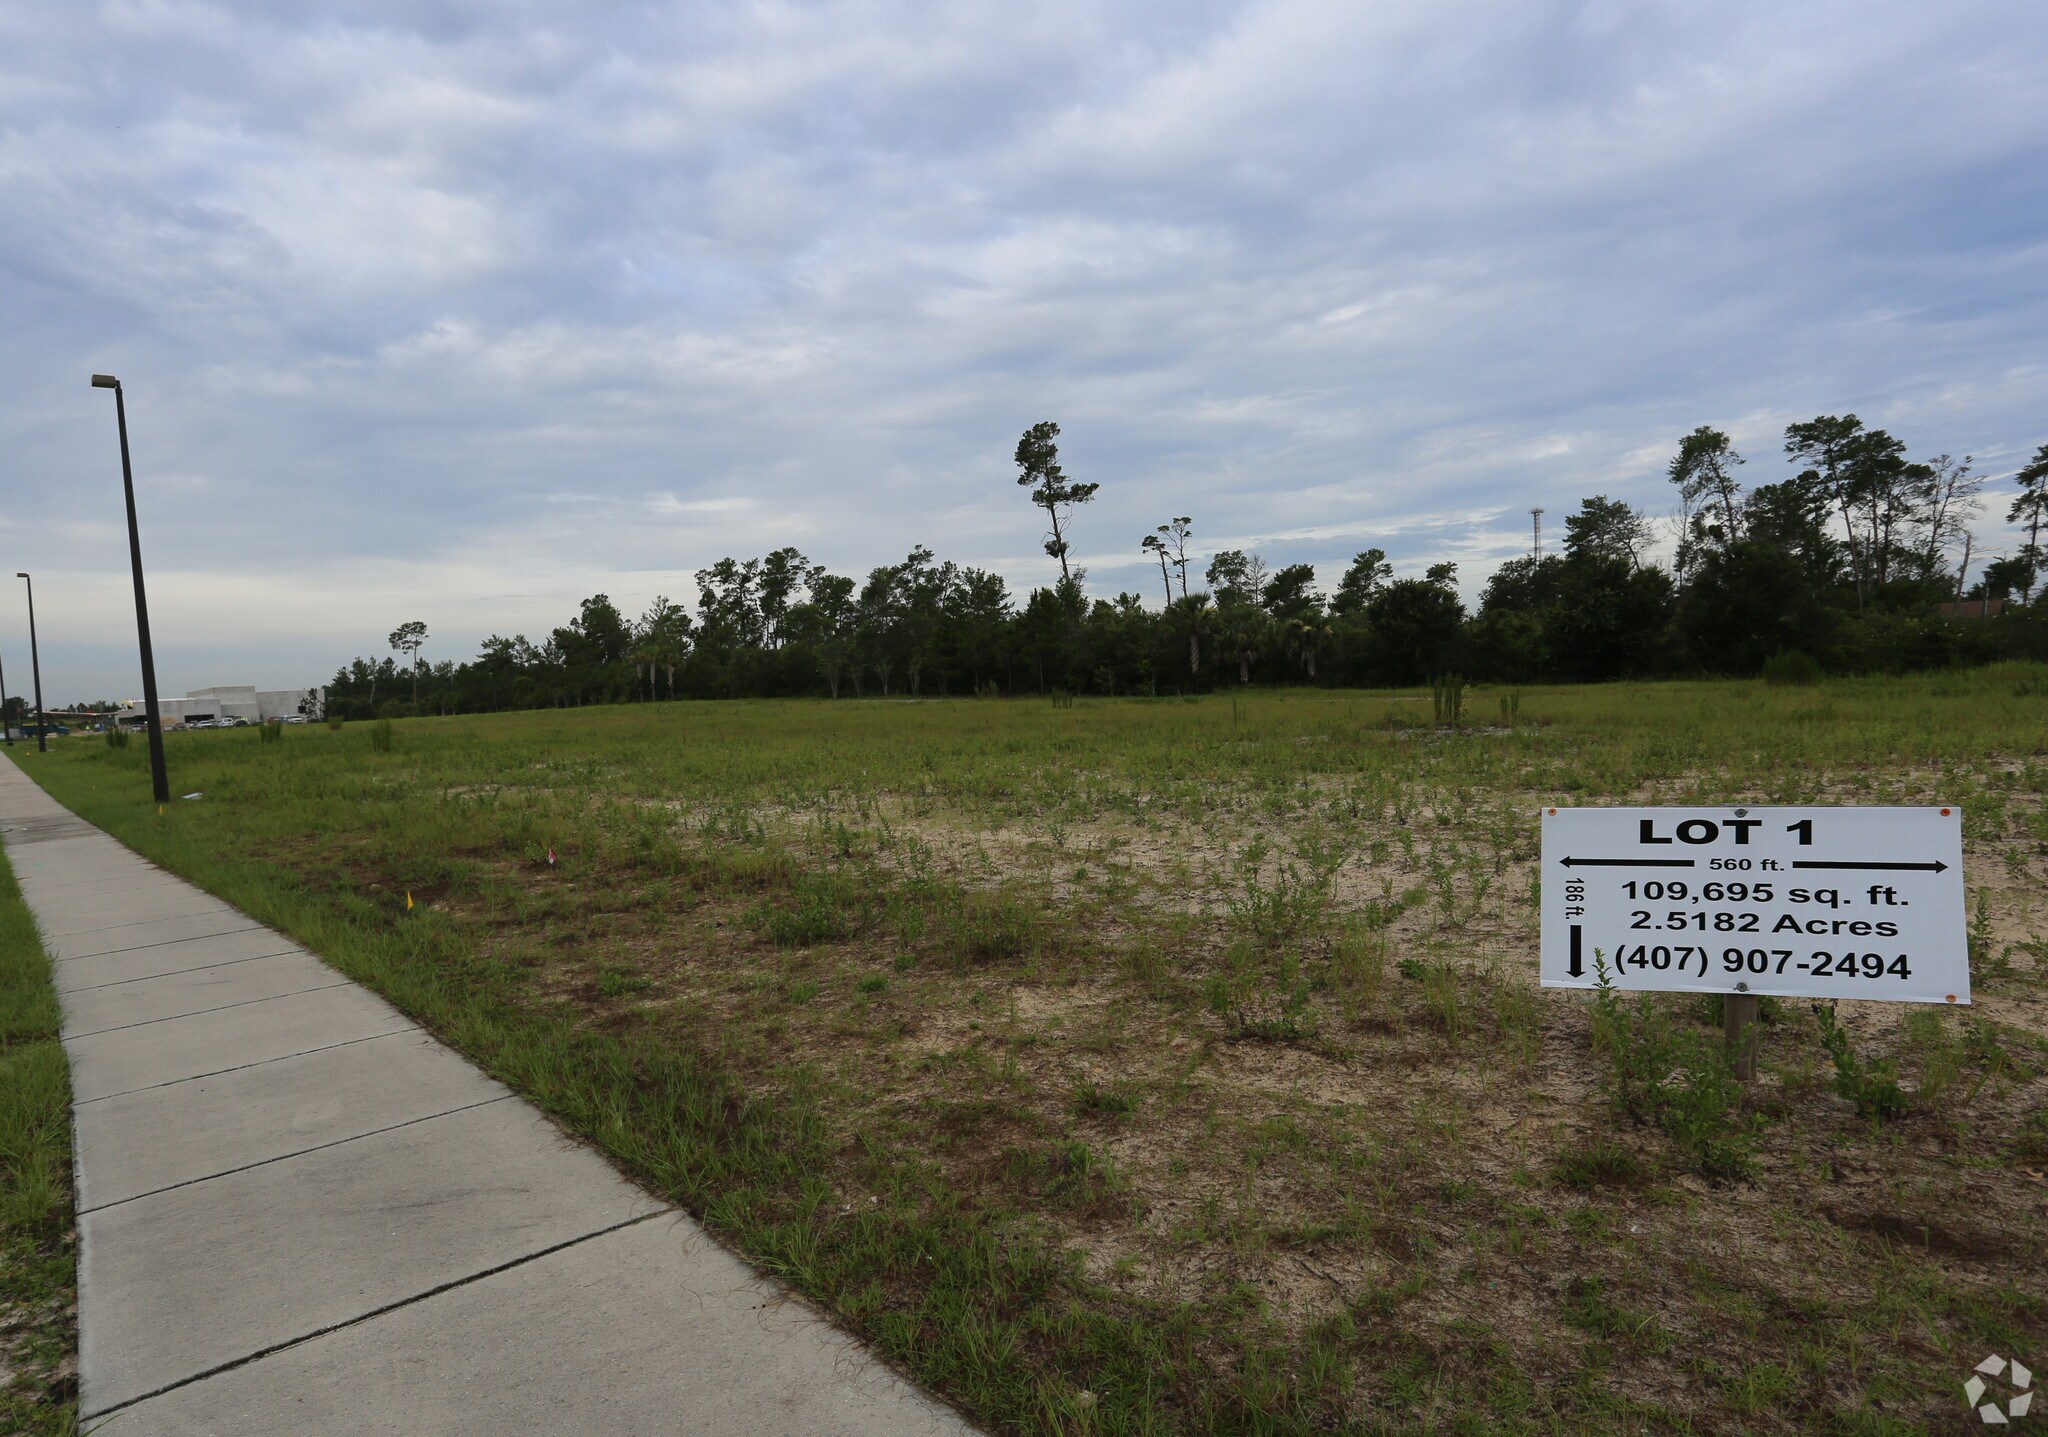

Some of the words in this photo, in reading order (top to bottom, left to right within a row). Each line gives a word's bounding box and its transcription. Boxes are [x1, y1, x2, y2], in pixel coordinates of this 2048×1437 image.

[1639, 819, 1762, 846] LOT
[1786, 819, 1814, 846] 1
[1709, 858, 1752, 871] 560
[1759, 858, 1785, 872] ft.
[1565, 877, 1585, 902] 186
[1621, 880, 1774, 905] 109,695
[1788, 887, 1851, 909] sq.
[1866, 884, 1909, 906] ft.
[1565, 905, 1585, 920] ft.
[1630, 910, 1760, 933] 2.5182
[1771, 913, 1899, 937] Acres
[1615, 944, 1709, 978] (407)
[1722, 947, 1912, 980] 907-2494
